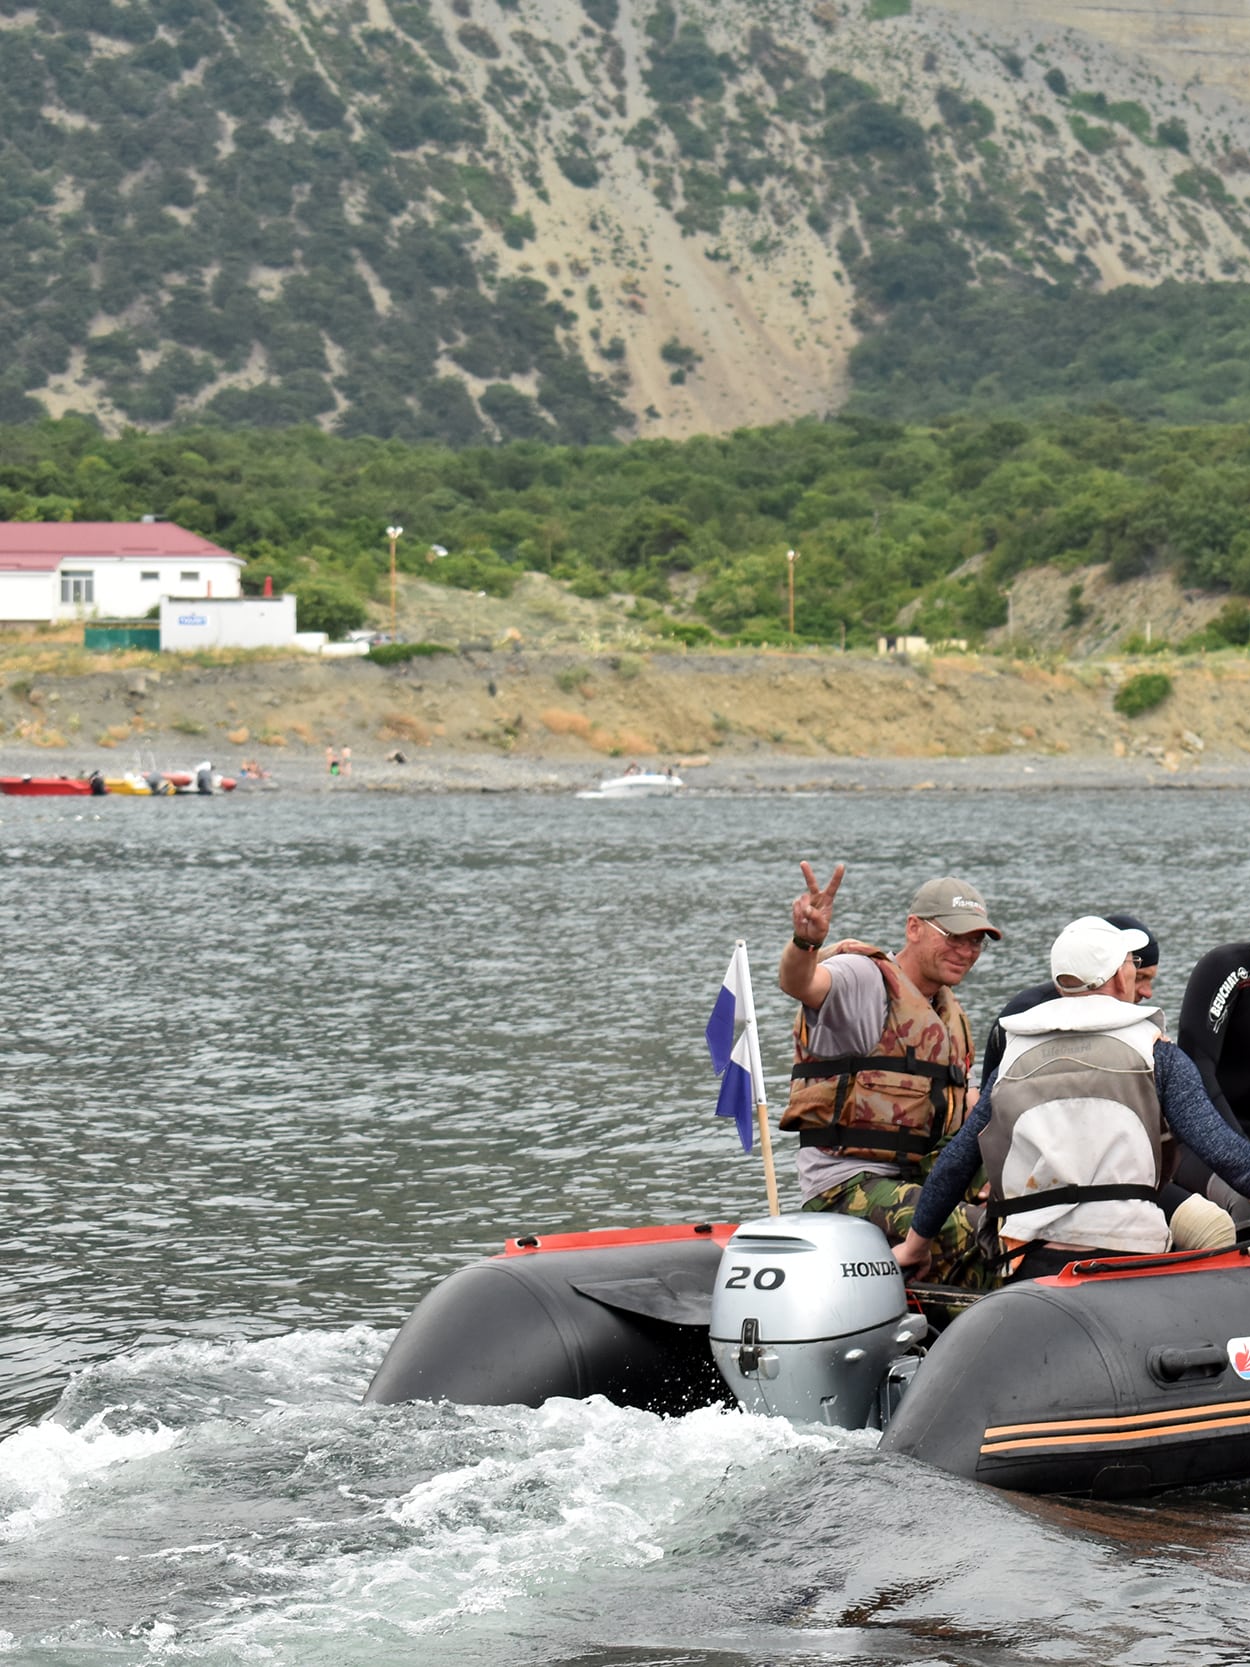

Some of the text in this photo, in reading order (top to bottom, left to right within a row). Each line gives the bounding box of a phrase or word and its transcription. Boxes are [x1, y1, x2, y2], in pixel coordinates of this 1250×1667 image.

[1210, 971, 1240, 1018] BEUCHAT
[725, 1266, 786, 1290] 20
[840, 1261, 899, 1277] HONDA
